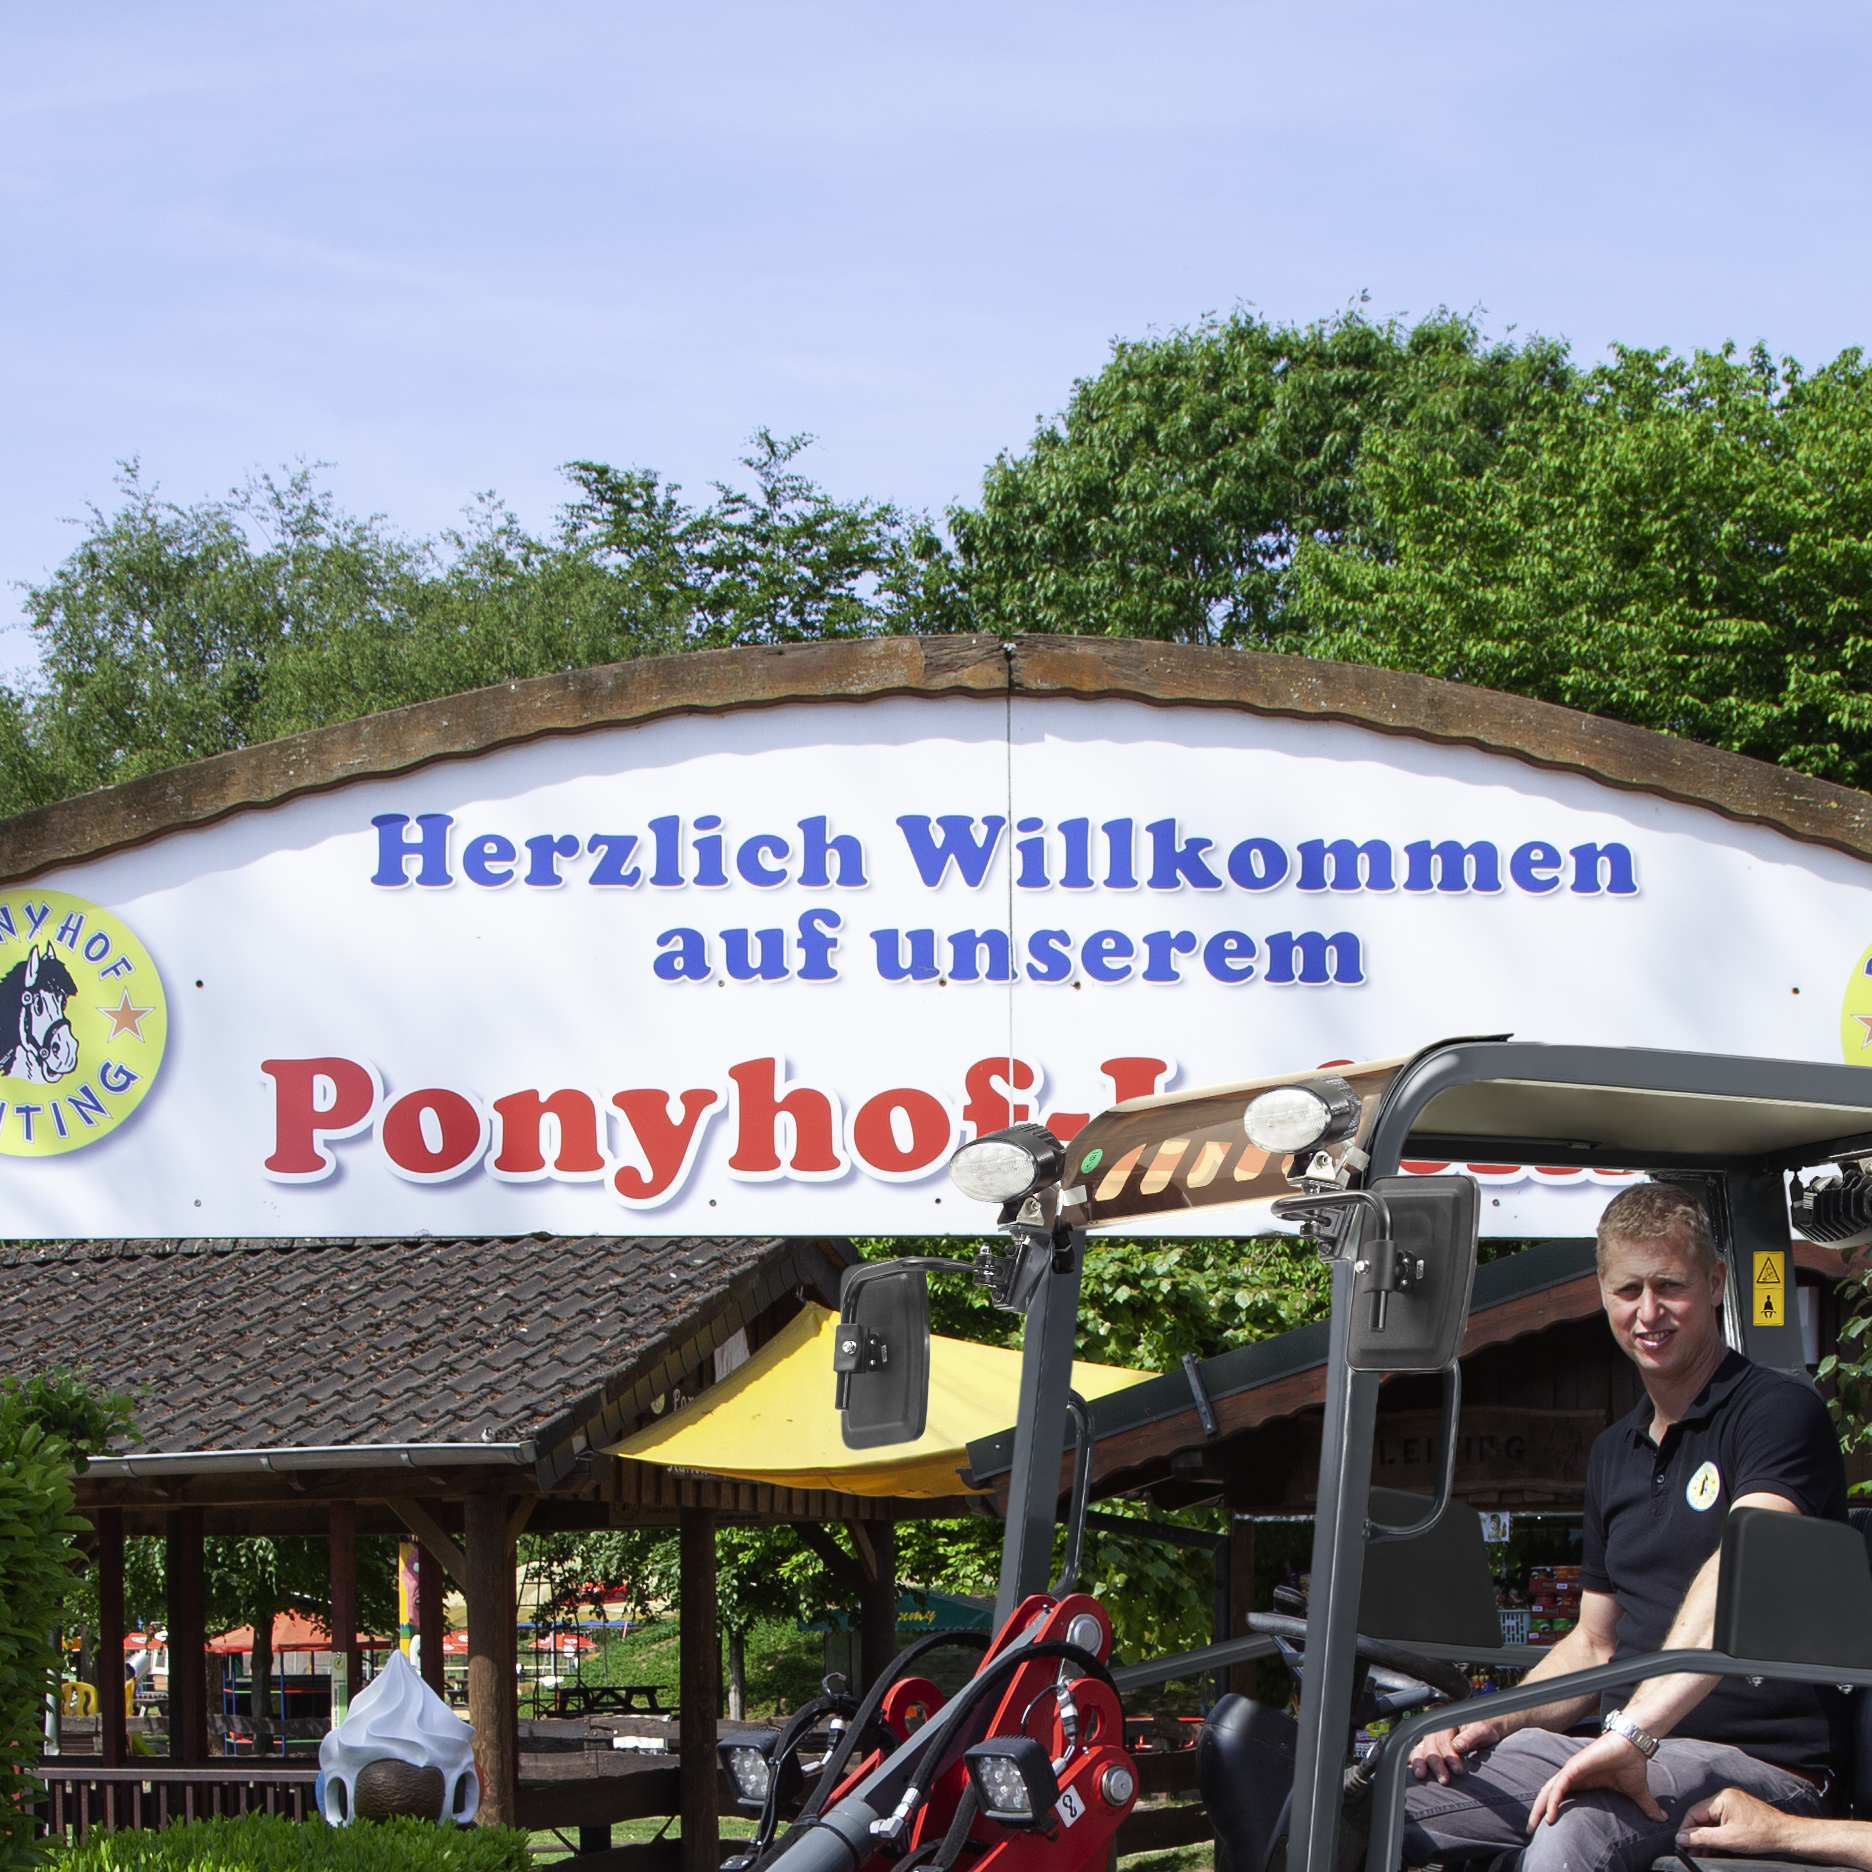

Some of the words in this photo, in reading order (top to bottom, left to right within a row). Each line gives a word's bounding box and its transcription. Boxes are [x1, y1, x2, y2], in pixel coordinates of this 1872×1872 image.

[370, 813, 868, 889] Herzlich
[895, 814, 1640, 893] Willkommen
[652, 908, 842, 981] auf
[869, 927, 1365, 984] unserem
[1380, 1434, 1527, 1466] LEIING
